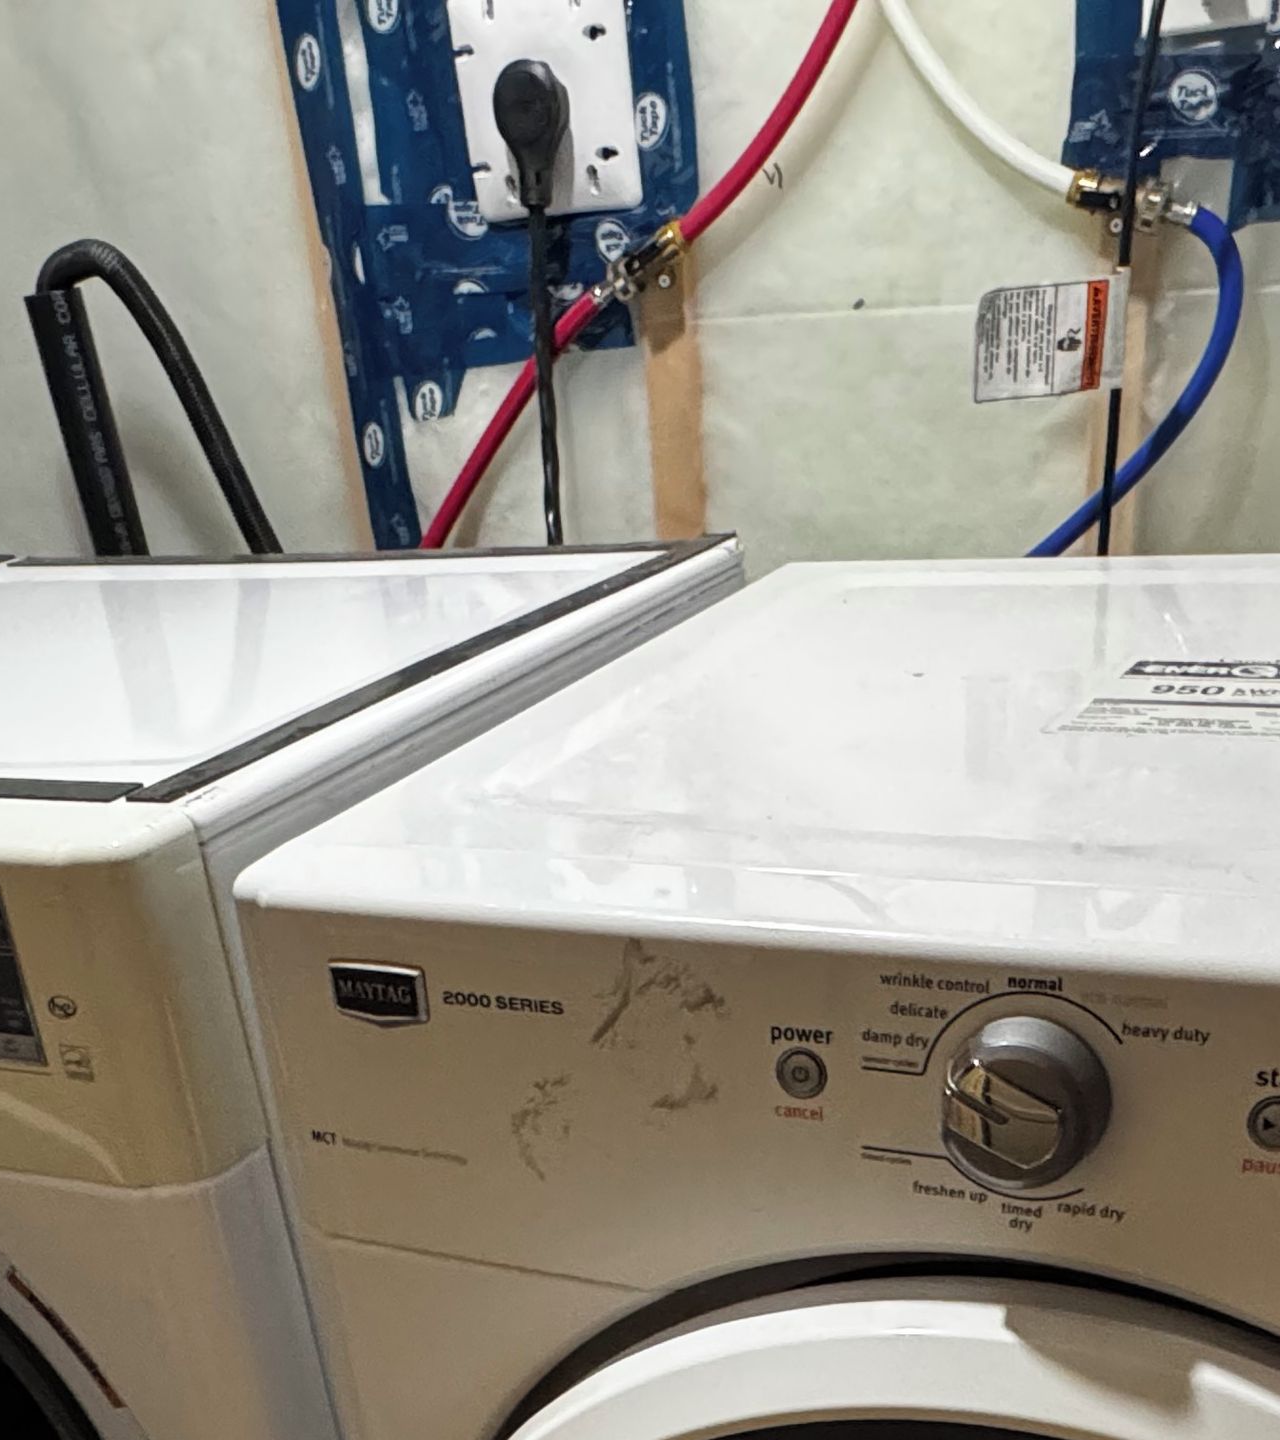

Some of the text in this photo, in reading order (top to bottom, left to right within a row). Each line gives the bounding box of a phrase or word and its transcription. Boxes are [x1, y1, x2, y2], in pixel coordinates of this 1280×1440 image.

[639, 105, 649, 143] Tuck
[649, 100, 660, 137] Tape
[1150, 684, 1225, 696] 950
[338, 978, 412, 1005] MAYTAG
[880, 972, 990, 995] wrinkle control
[1007, 975, 1063, 993] normal
[442, 990, 565, 1016] 2000 SERIES
[889, 1001, 948, 1020] delicate
[770, 1025, 833, 1047] power
[861, 1027, 930, 1050] damp dry
[1121, 1023, 1211, 1046] heavy duty
[774, 1102, 824, 1122] cancel
[912, 1180, 989, 1204] freshen up
[1001, 1202, 1043, 1220] timed
[1057, 1201, 1127, 1224] rapid dry
[1008, 1216, 1034, 1233] dry
